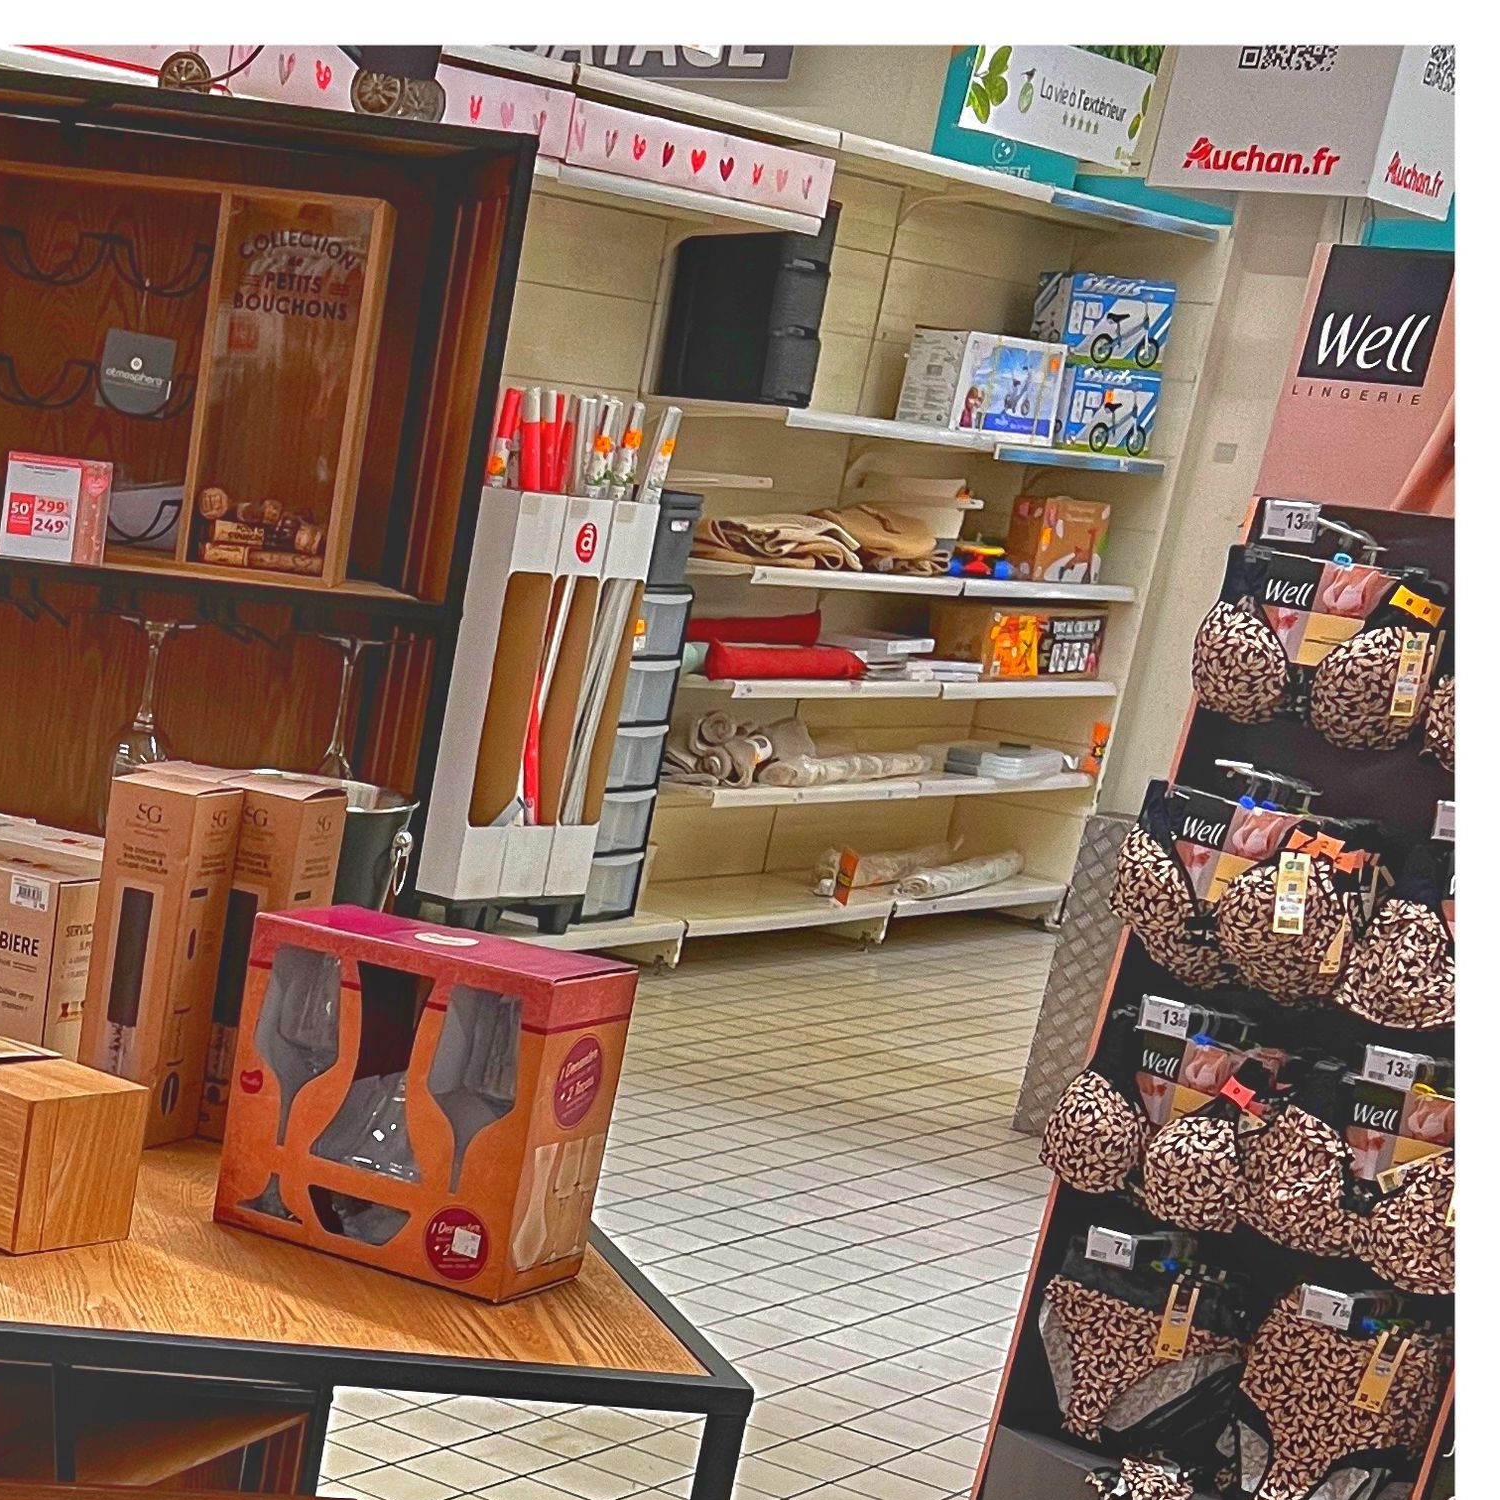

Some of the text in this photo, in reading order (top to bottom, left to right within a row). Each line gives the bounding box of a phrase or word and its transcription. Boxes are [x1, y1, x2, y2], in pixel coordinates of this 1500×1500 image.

[1182, 136, 1340, 176] Auchan.fr
[1385, 150, 1444, 199] Auchan.fr
[238, 229, 357, 270] COLLECTION
[265, 271, 322, 294] PETITS
[233, 290, 348, 321] BOUCHONS
[1317, 312, 1431, 373] Well
[1291, 384, 1421, 406] LINGERIE
[1265, 579, 1314, 606] Well
[1182, 816, 1226, 846] Well
[66, 923, 92, 938] SERVIC
[1142, 1049, 1180, 1078] Well
[1353, 1102, 1398, 1131] Well
